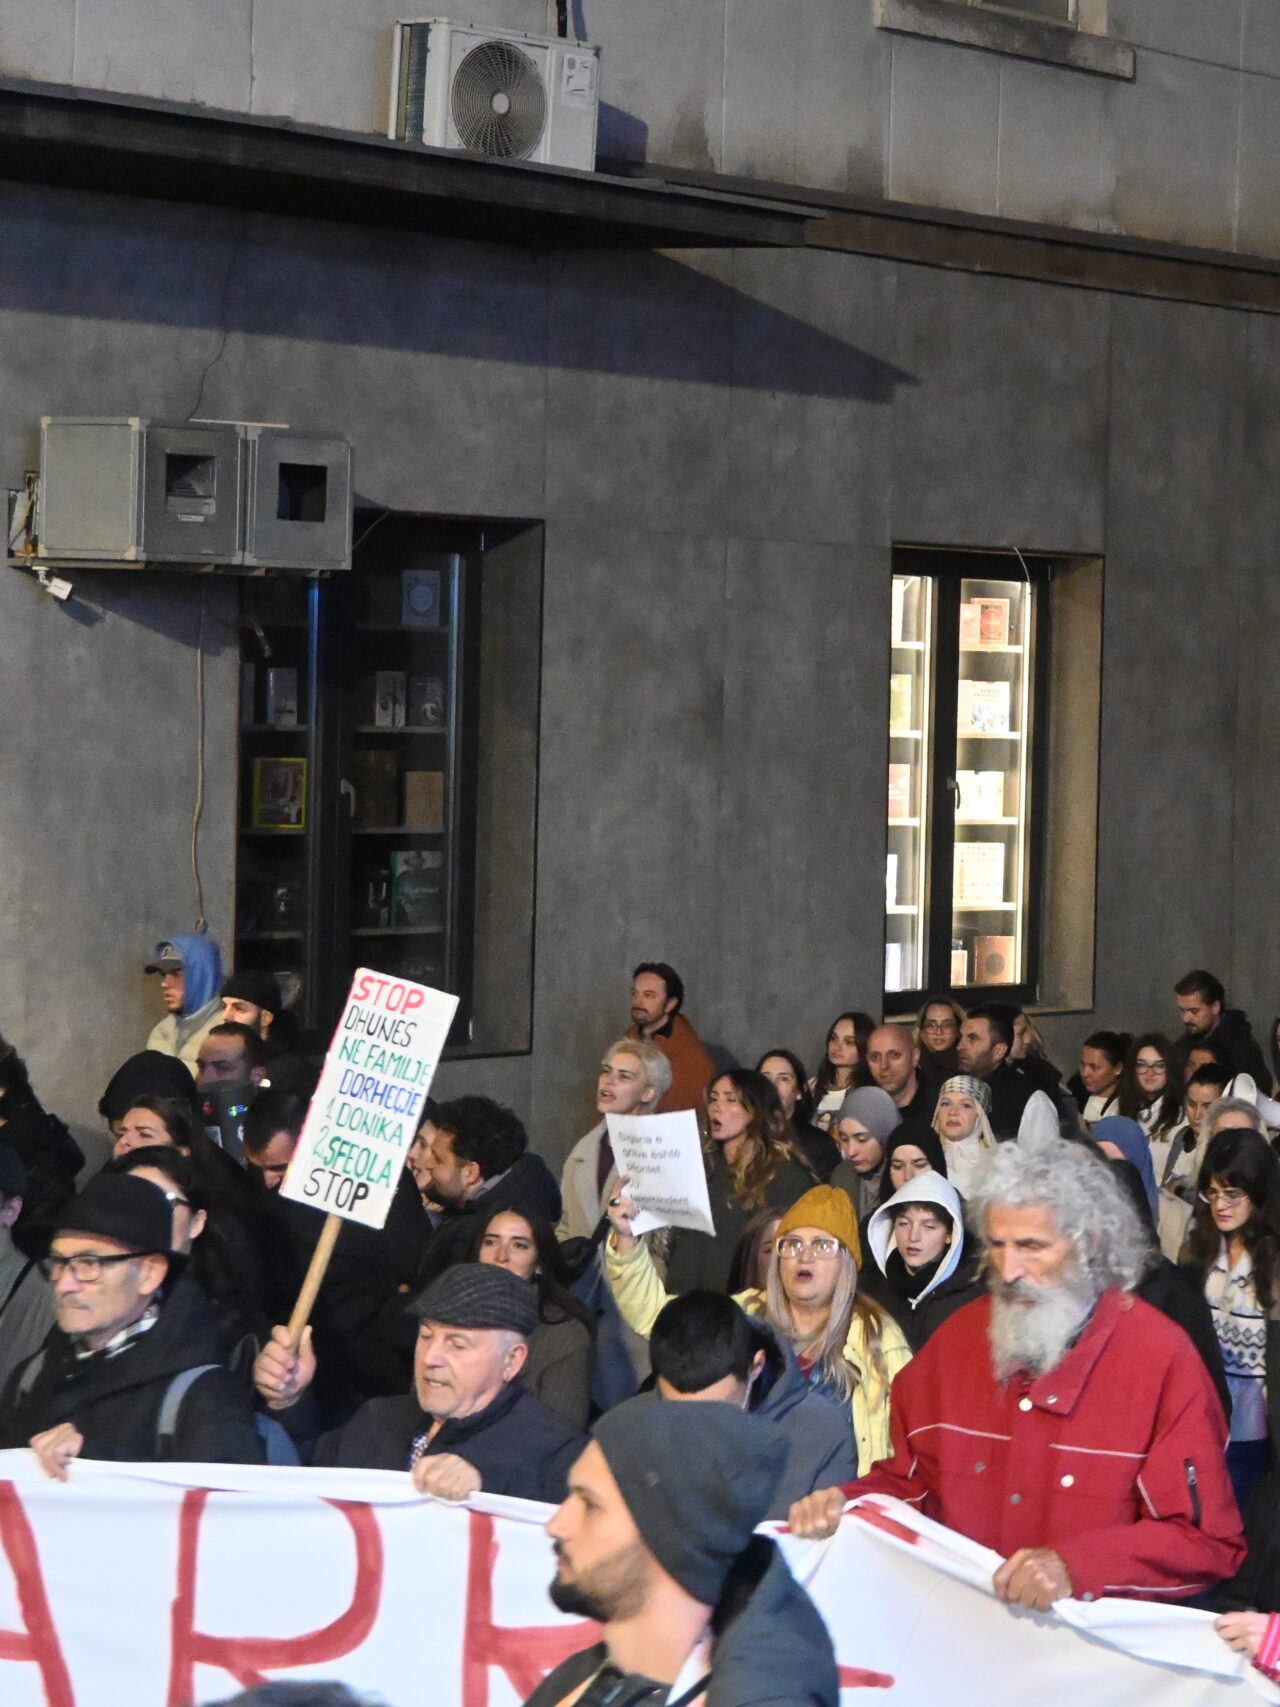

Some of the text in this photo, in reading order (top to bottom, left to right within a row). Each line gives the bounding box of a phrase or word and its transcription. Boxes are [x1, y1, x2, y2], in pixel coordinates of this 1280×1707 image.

[352, 975, 425, 1014] STOP
[344, 1005, 417, 1047] DHUNES
[338, 1036, 432, 1086] NE FAMILJE
[303, 1167, 370, 1212] STOP
